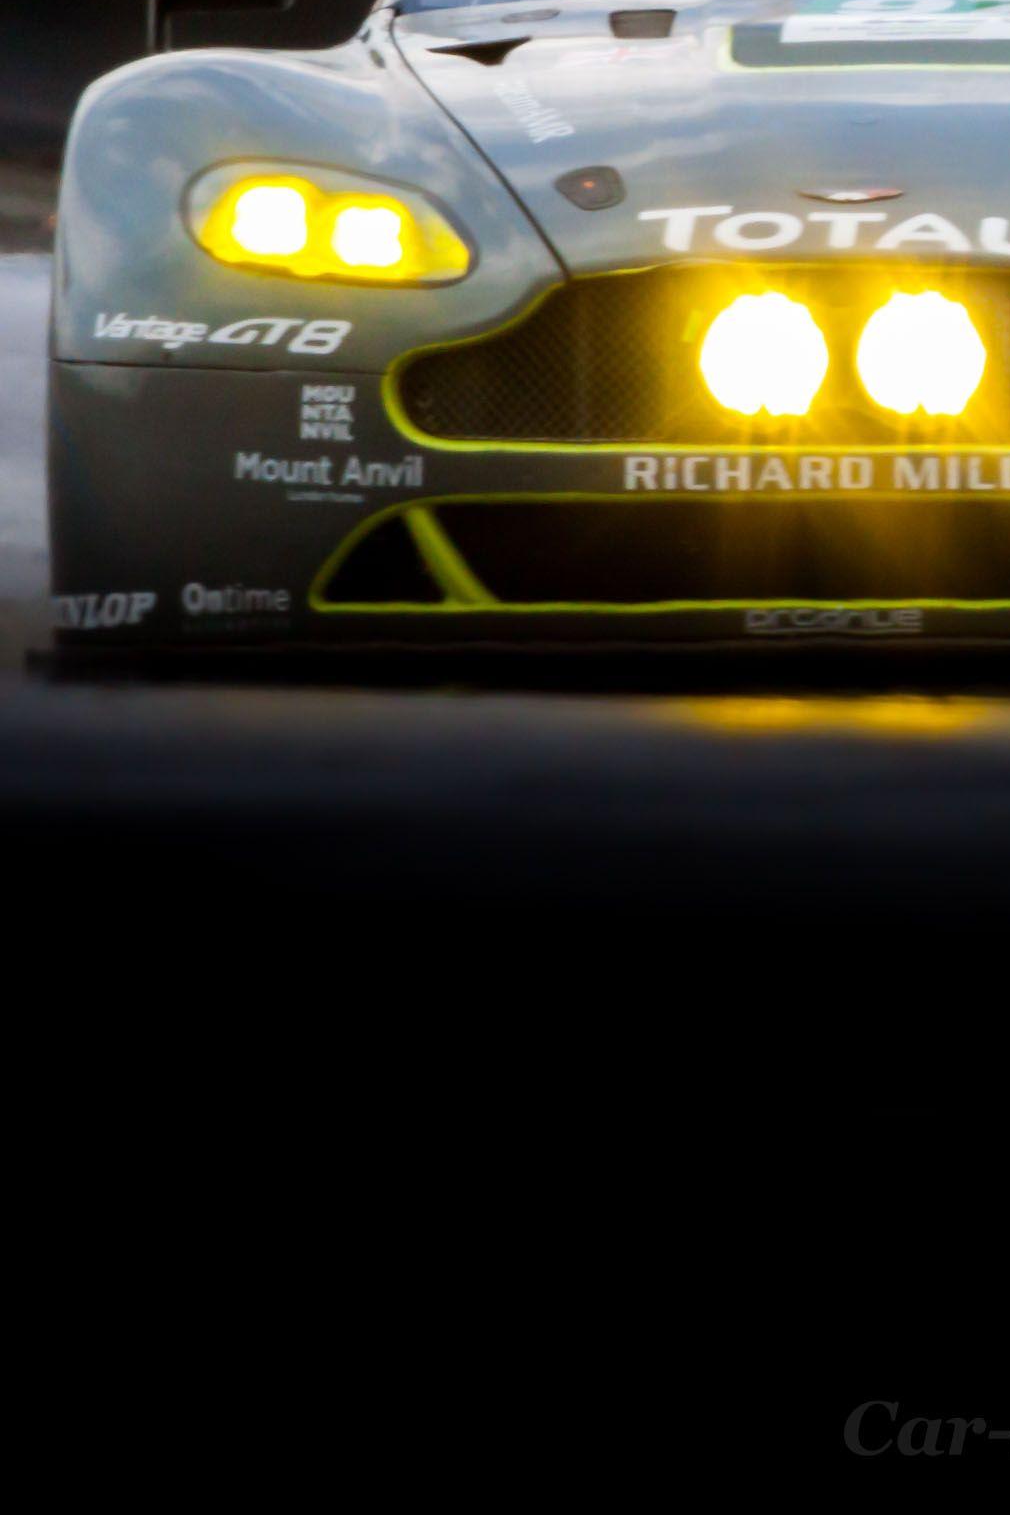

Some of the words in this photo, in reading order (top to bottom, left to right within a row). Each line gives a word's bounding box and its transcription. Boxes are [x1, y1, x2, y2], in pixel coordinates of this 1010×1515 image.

[94, 312, 208, 350] Vantage
[208, 318, 352, 355] GT8
[234, 452, 334, 485] Mount
[341, 455, 424, 487] Anvil
[623, 455, 874, 491] RICHARD
[181, 581, 291, 616] Ontime
